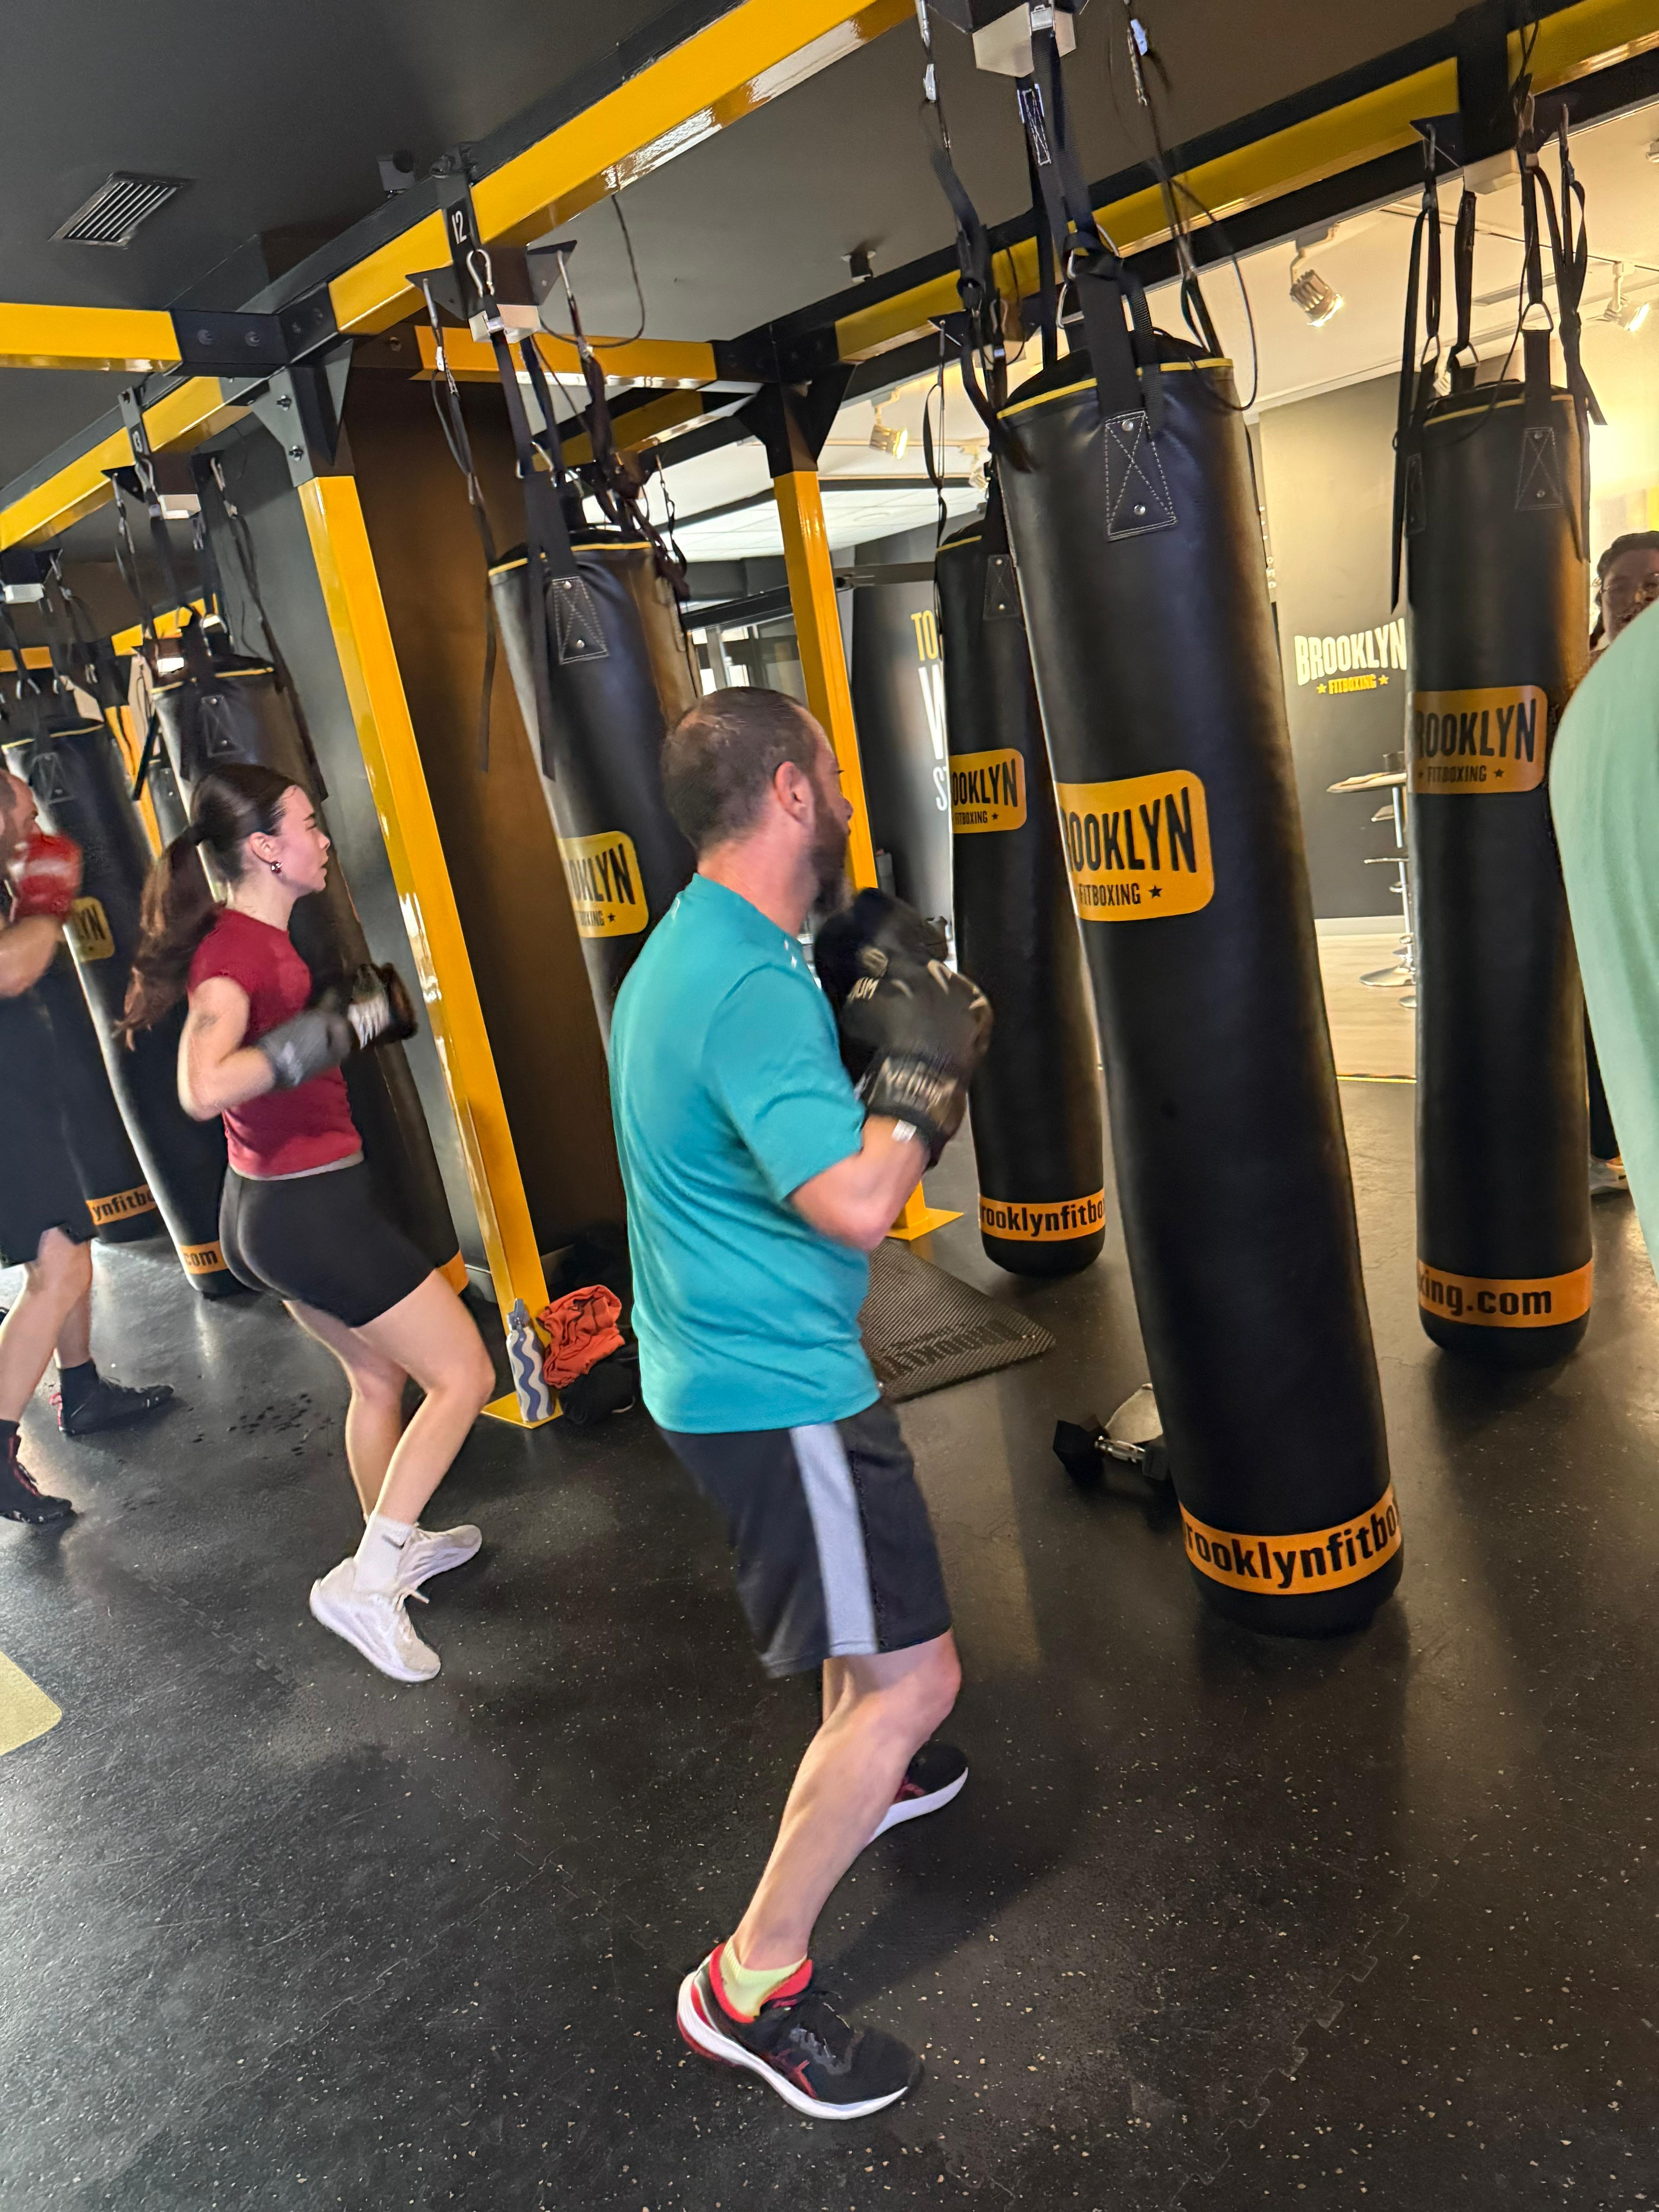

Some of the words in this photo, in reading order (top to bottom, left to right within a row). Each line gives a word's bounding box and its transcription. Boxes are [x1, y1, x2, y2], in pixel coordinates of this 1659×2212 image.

[451, 210, 467, 245] 12
[1294, 617, 1407, 686] BROOKLYN
[1328, 674, 1377, 695] FITBOXING
[933, 766, 948, 811] S
[951, 758, 1018, 807] OOKLYN
[1427, 765, 1487, 783] FITBOXING
[1078, 882, 1141, 906] FITBOXING
